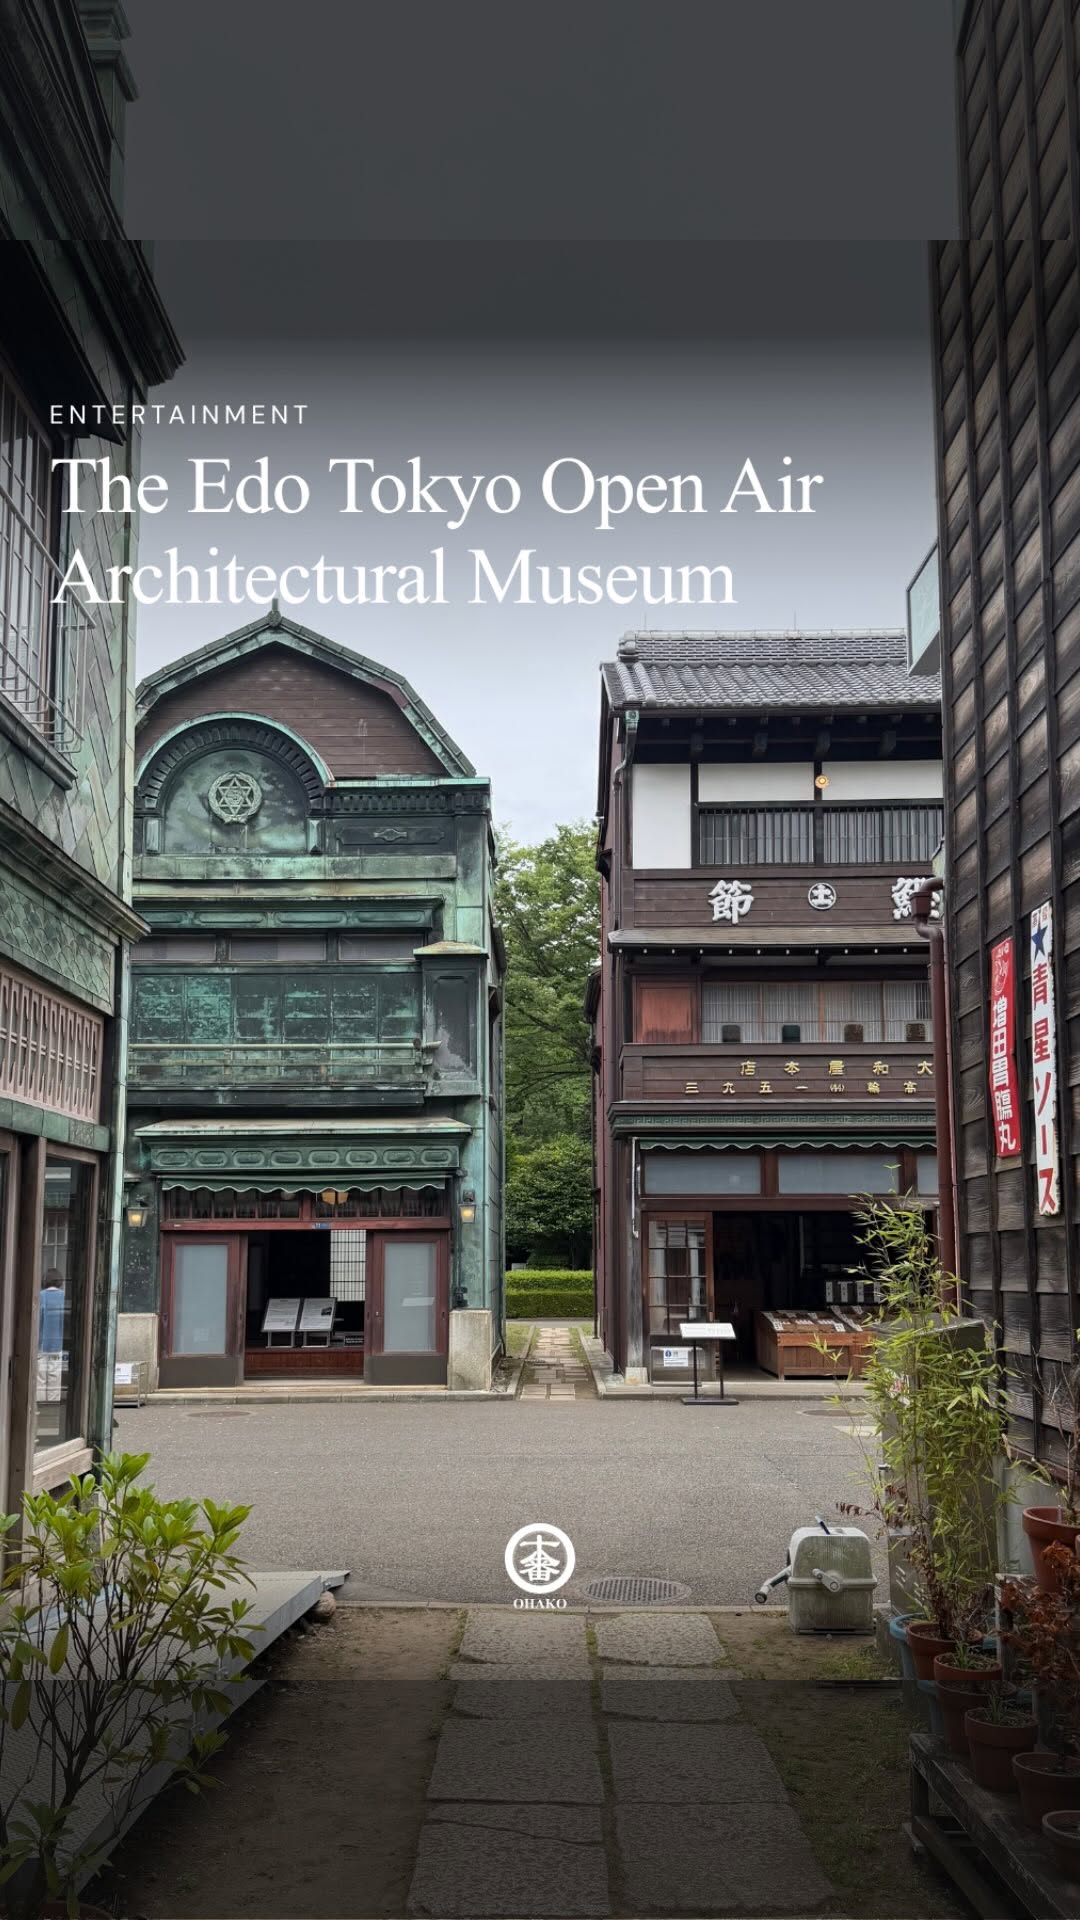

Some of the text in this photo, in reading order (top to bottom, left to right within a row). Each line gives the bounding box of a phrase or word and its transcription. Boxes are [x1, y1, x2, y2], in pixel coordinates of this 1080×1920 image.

[1032, 963, 1056, 1212] 青星ソース
